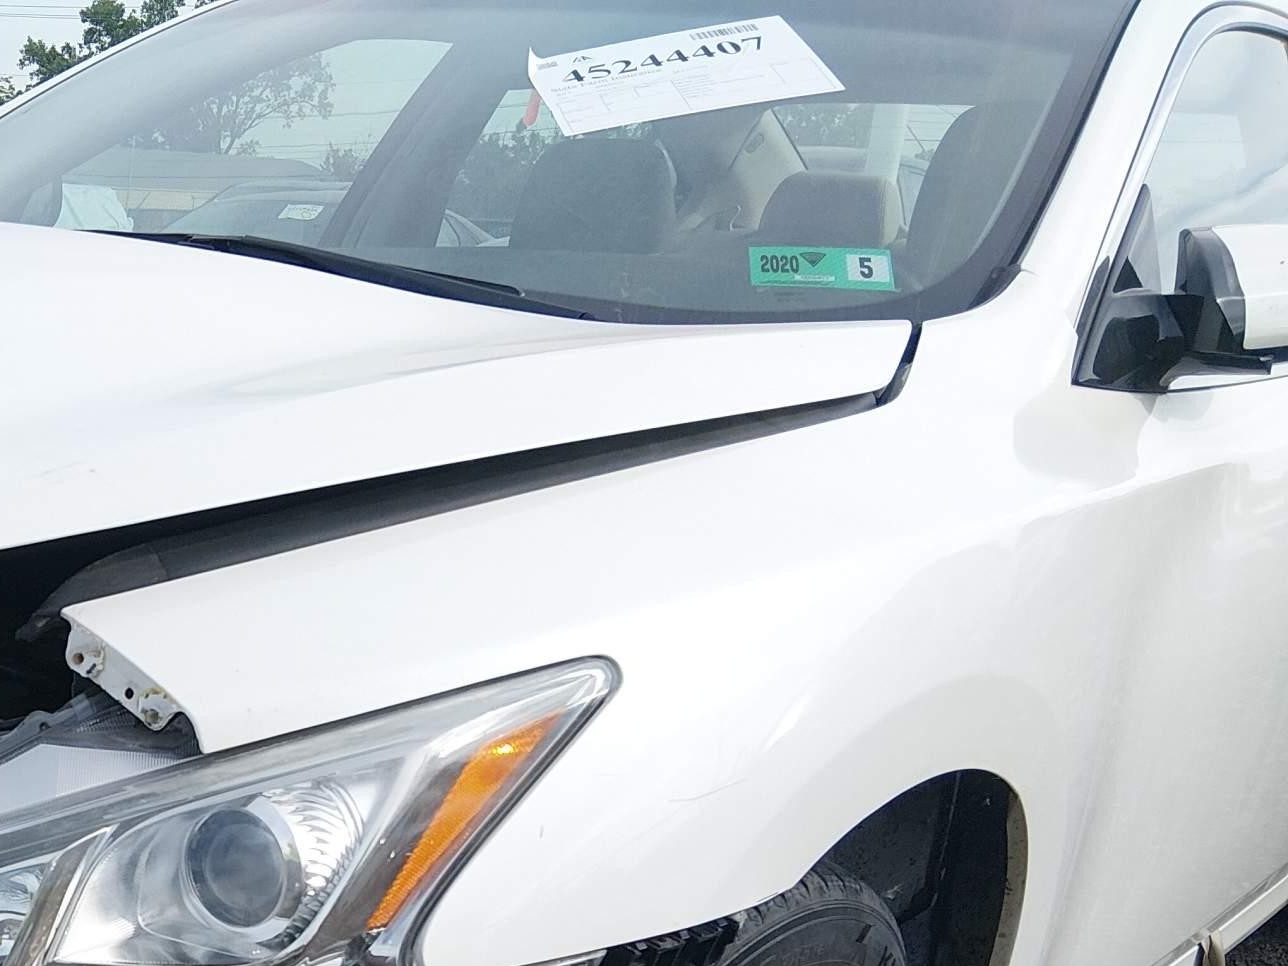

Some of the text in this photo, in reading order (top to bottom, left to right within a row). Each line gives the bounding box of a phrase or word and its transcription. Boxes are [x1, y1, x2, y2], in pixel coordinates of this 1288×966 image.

[562, 35, 763, 82] 45244407
[760, 254, 800, 274] 2020
[858, 256, 874, 279] 5
